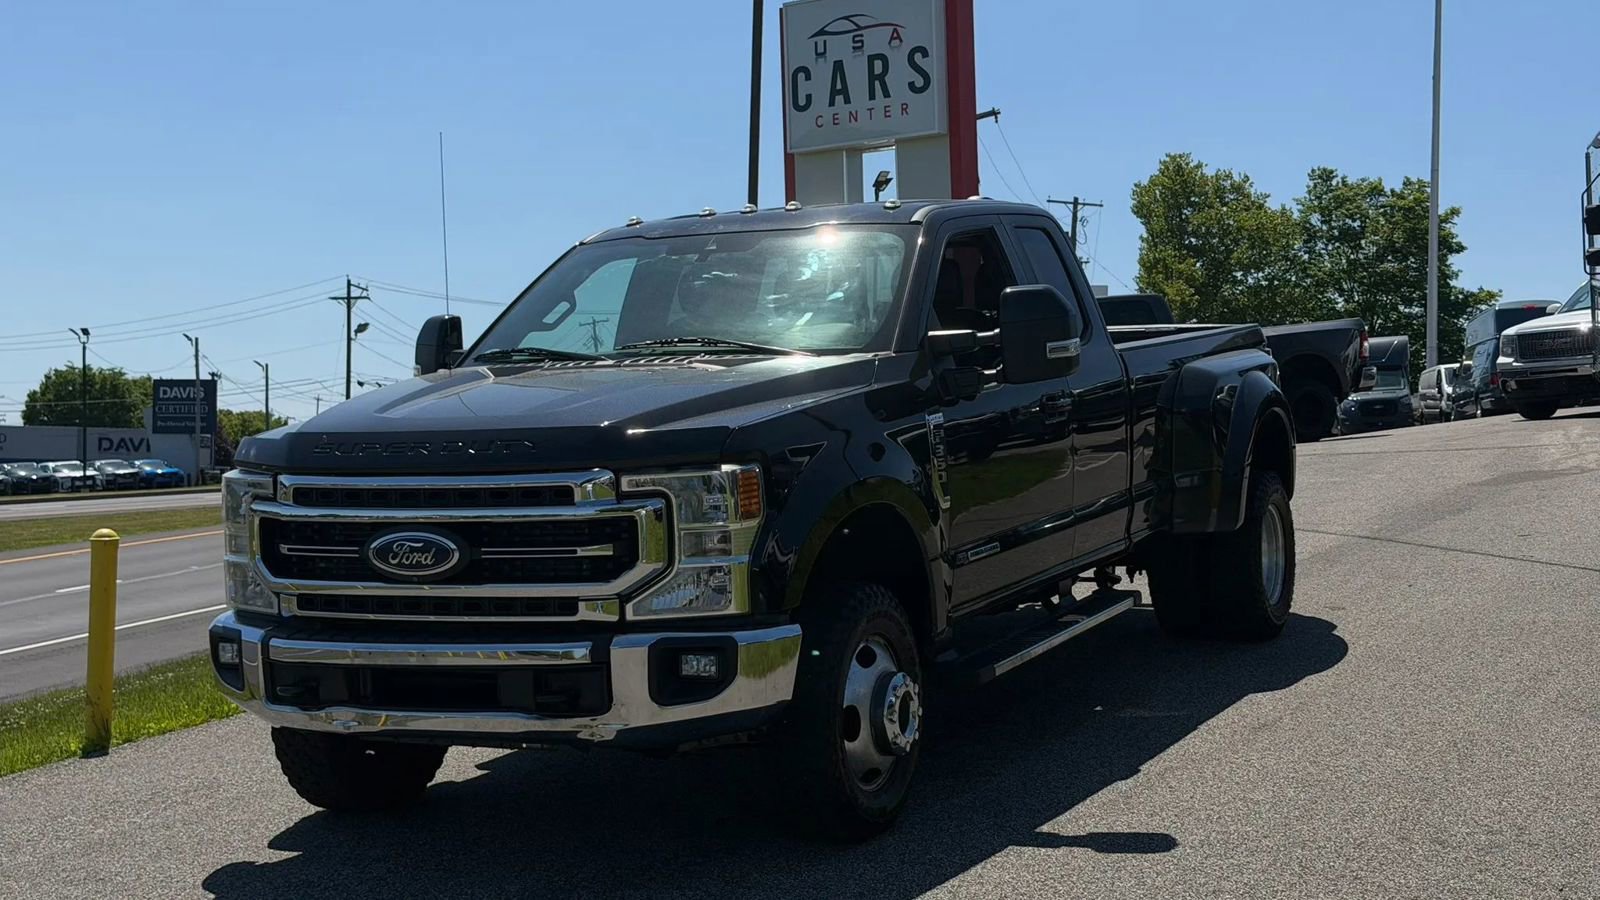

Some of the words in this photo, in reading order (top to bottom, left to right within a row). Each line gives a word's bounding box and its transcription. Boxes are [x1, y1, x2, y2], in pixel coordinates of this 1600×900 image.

[791, 45, 932, 113] CARS
[815, 102, 909, 129] CENTER
[159, 386, 205, 399] DAVIS
[155, 405, 209, 413] CERTIFID
[312, 441, 432, 456] SUPER
[440, 439, 538, 455] DUTY
[388, 541, 436, 565] Ford
